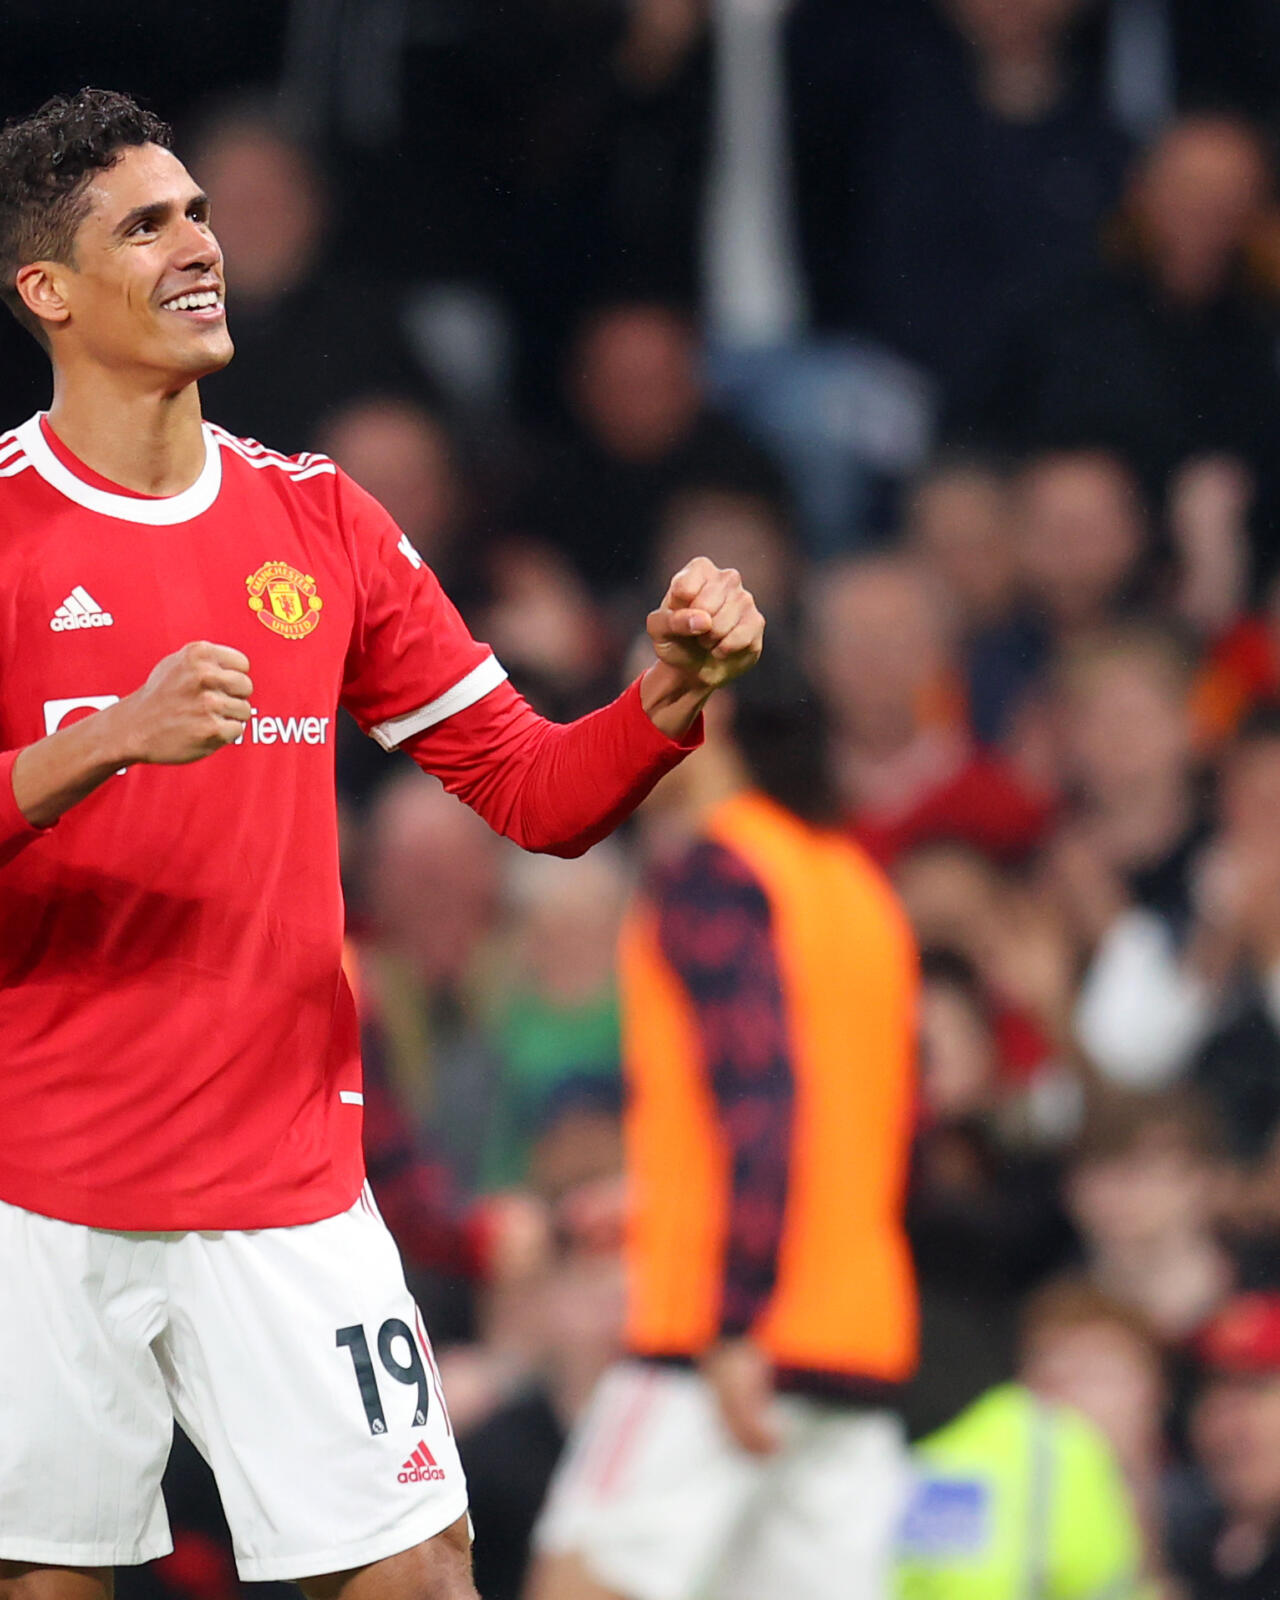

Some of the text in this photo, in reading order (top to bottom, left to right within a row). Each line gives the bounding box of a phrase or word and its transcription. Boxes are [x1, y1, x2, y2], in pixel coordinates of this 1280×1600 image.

[251, 567, 312, 592] MANCHESTER
[49, 610, 114, 632] adidas
[271, 619, 312, 633] UNITED
[335, 1318, 429, 1436] 19
[397, 1466, 446, 1484] adidas
